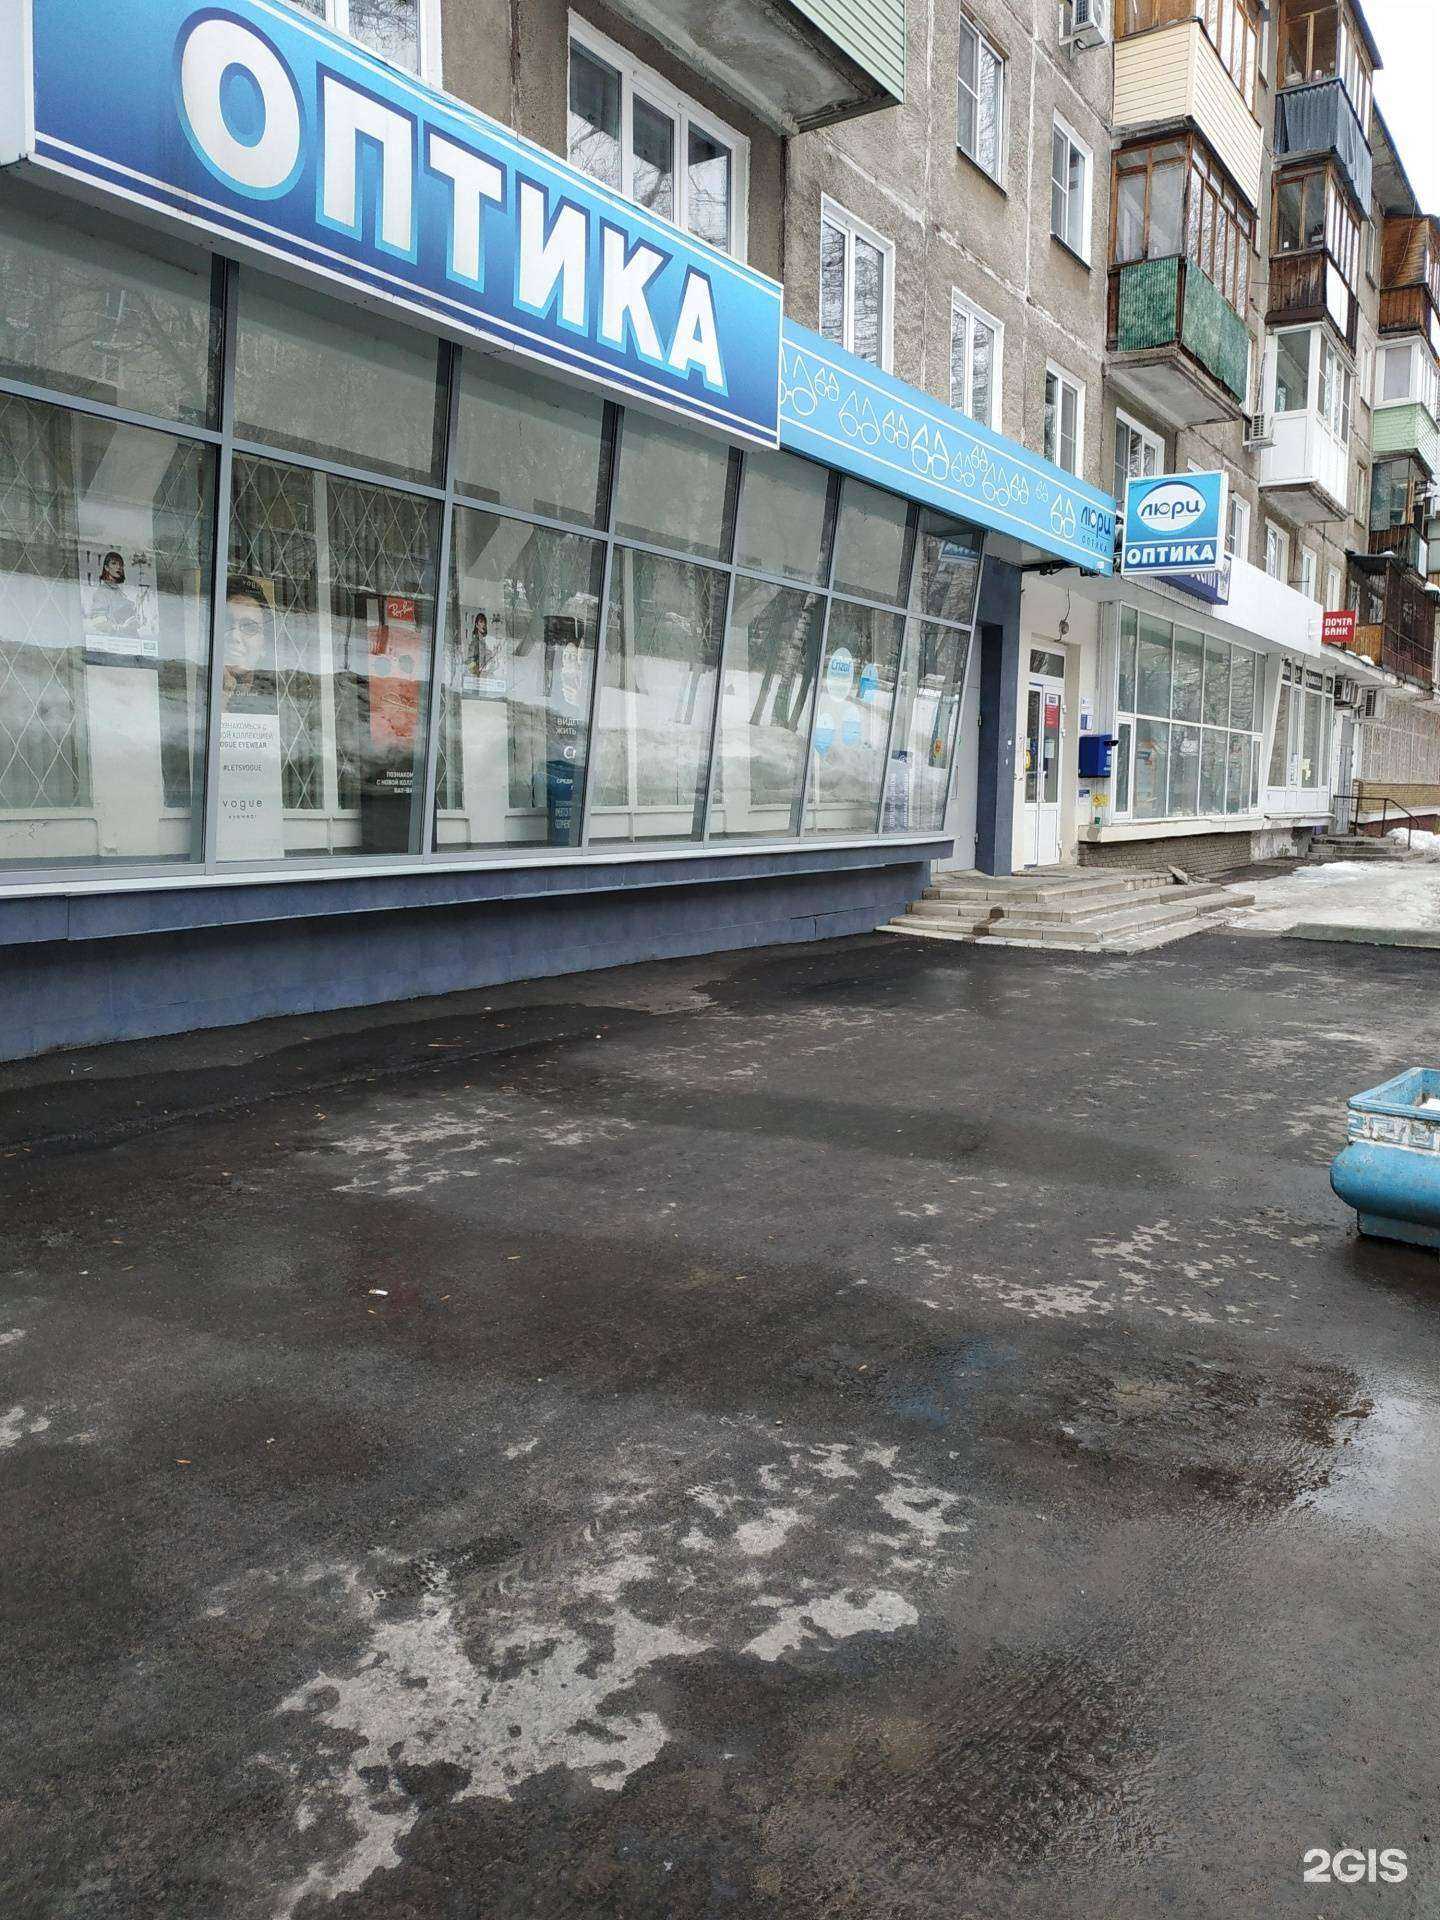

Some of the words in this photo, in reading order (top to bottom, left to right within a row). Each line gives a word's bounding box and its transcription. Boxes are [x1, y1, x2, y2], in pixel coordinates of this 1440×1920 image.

[177, 12, 728, 392] ОПТИКА
[1126, 544, 1215, 565] ОПТИКА
[1325, 617, 1353, 627] ПОЧТА
[1324, 626, 1349, 636] БАНК
[219, 741, 237, 749] OGUE
[238, 741, 267, 749] EYEWEAR
[223, 799, 263, 811] vogue
